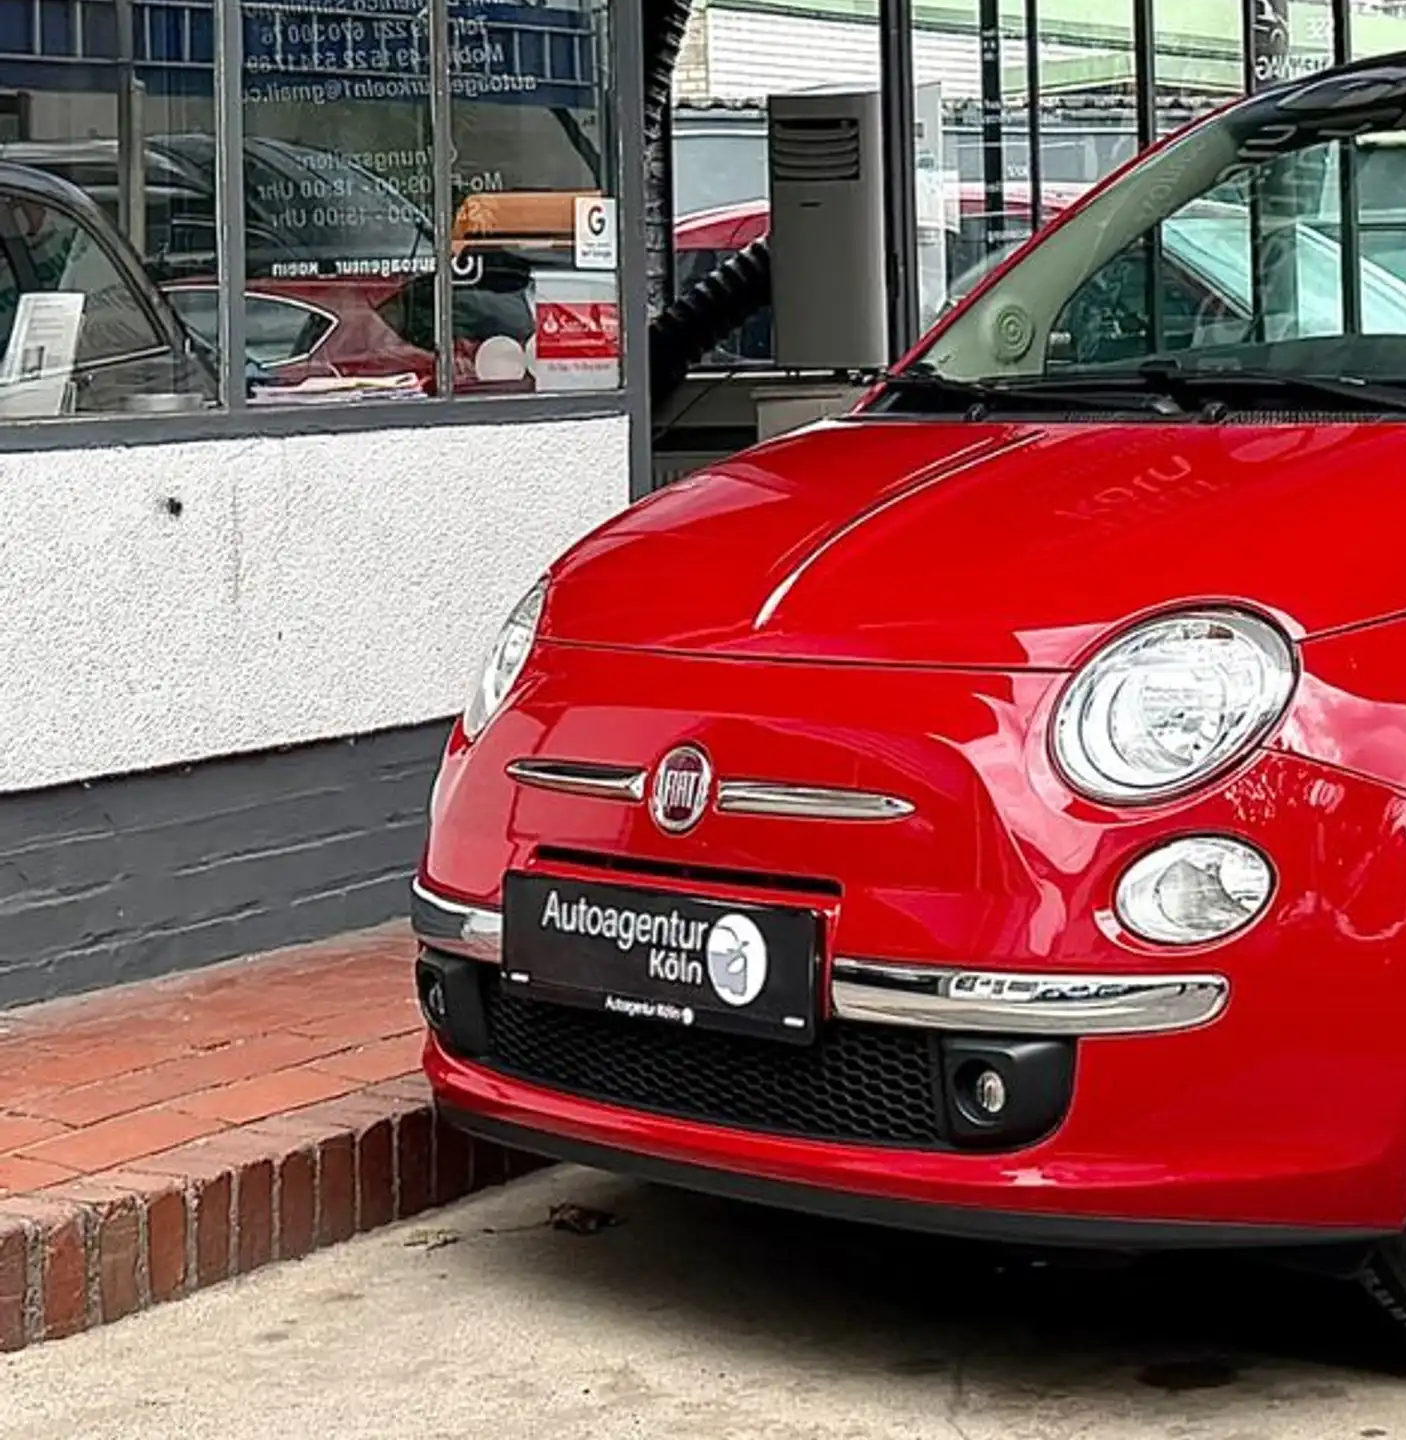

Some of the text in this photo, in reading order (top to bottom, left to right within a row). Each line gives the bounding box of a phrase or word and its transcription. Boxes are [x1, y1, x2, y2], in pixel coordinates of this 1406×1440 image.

[664, 769, 700, 810] FIAT
[541, 890, 709, 951] Autoagentur
[649, 948, 702, 985] Köln
